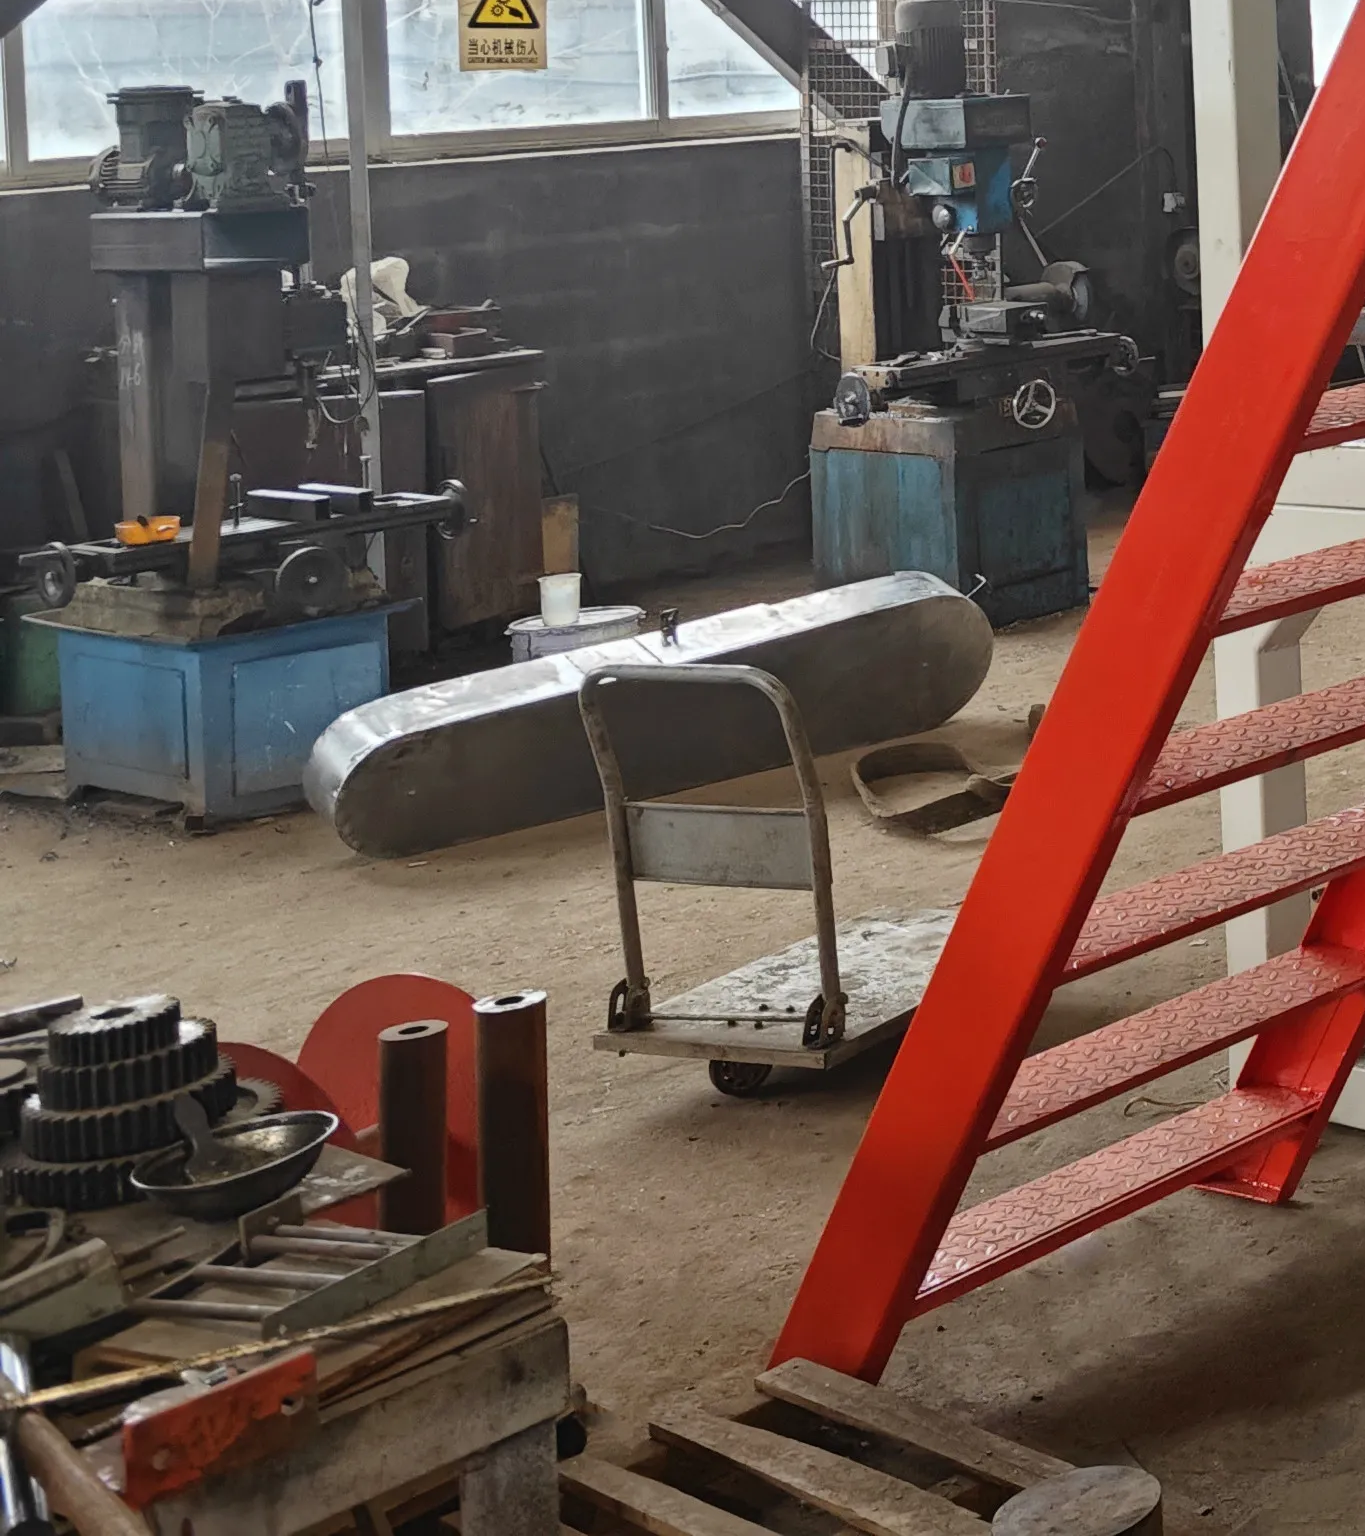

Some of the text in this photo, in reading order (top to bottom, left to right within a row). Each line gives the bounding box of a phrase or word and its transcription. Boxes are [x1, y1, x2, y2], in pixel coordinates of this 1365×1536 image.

[467, 38, 538, 56] 当心机械伤人
